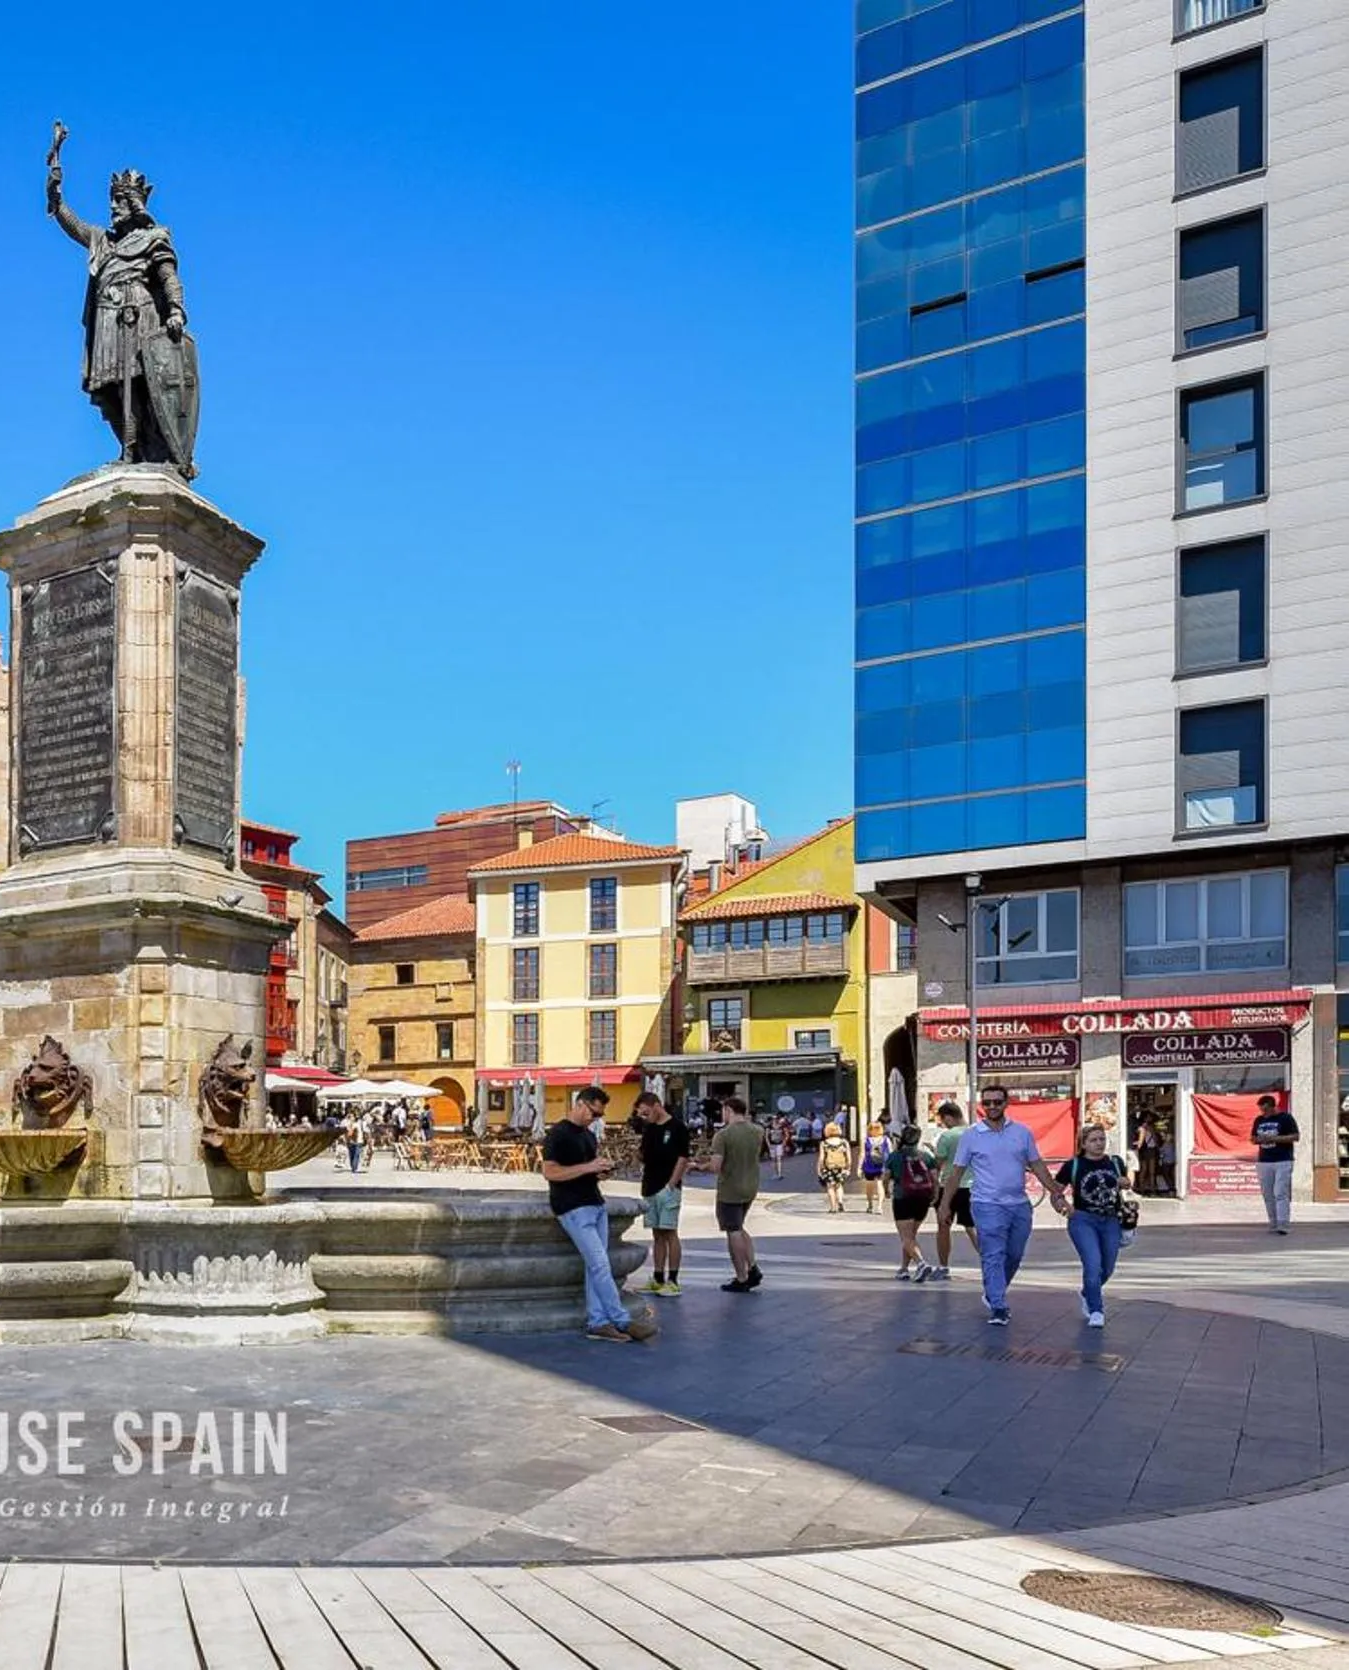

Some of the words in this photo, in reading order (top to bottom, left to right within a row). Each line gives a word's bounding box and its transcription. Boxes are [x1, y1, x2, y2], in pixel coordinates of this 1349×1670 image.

[1062, 1010, 1195, 1034] COLLADA
[978, 1042, 1069, 1059] COLLADA
[1153, 1034, 1254, 1052] COLLADA
